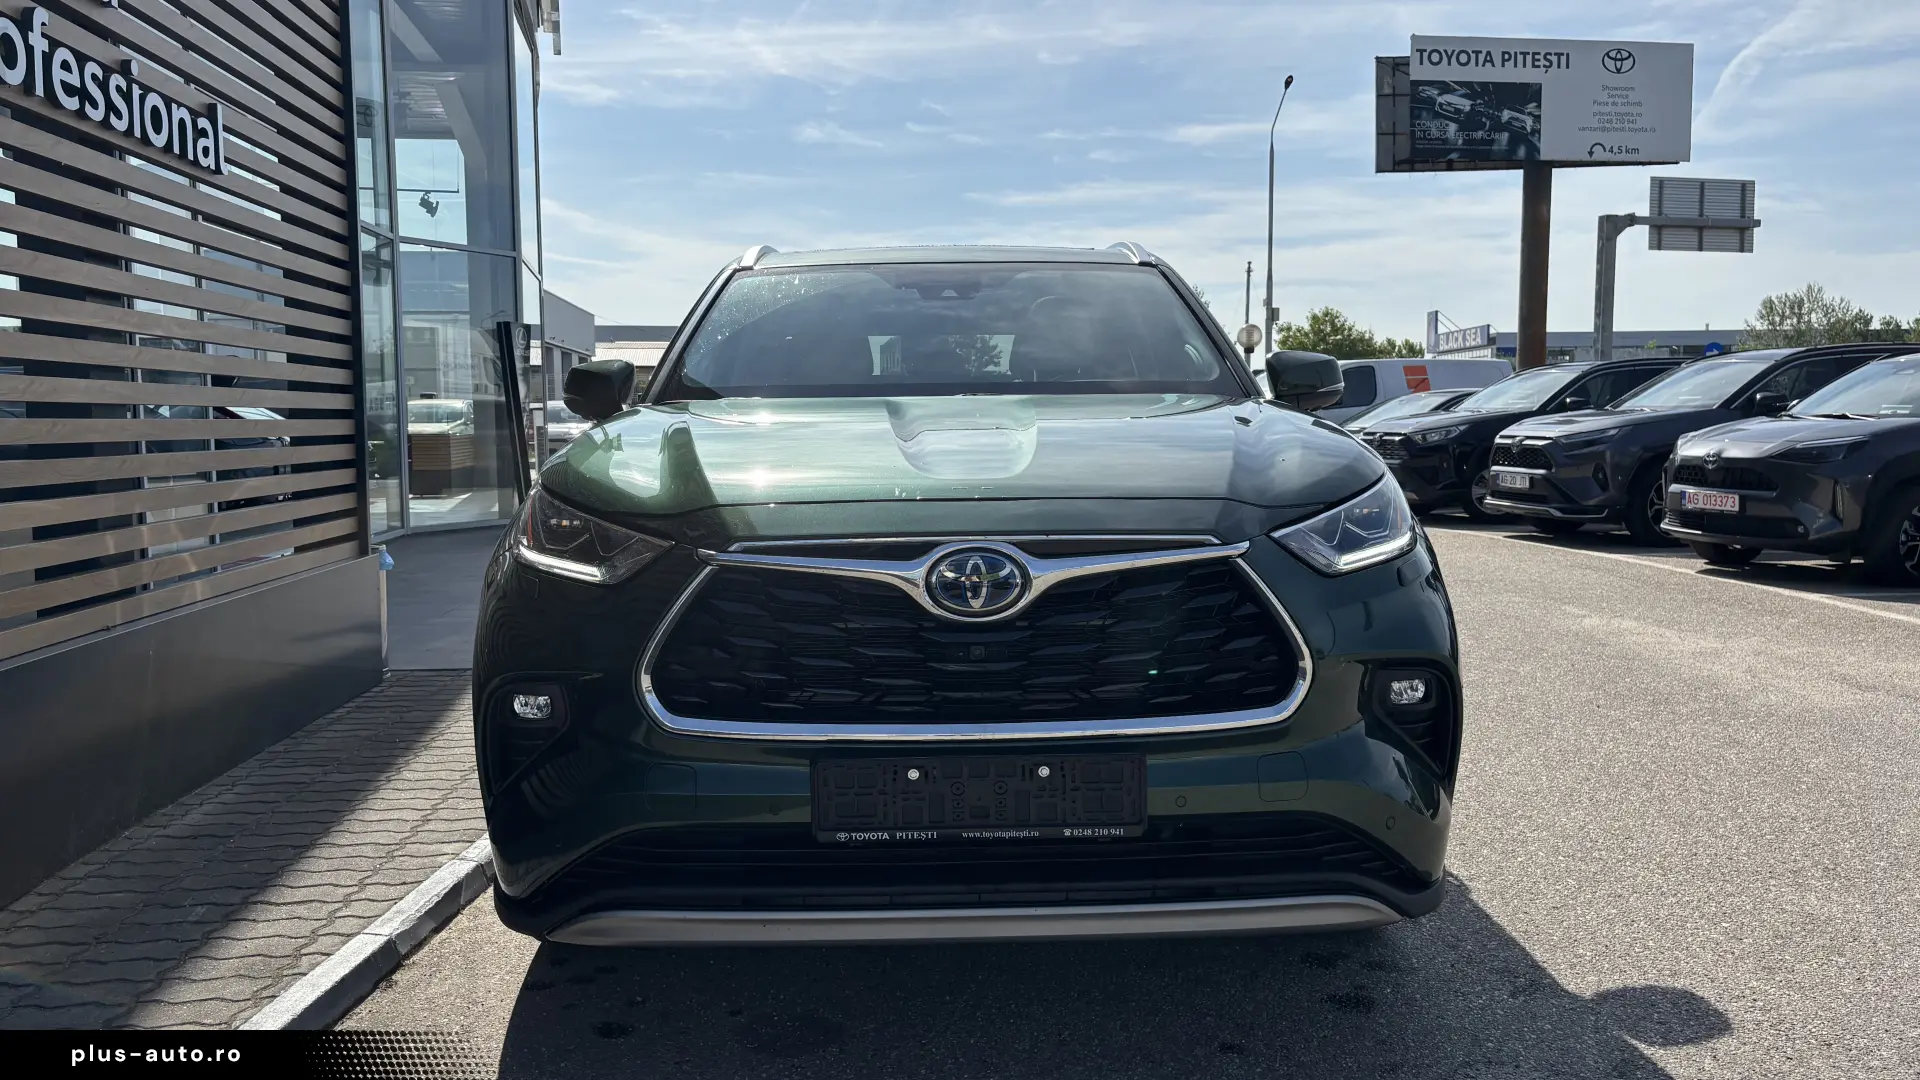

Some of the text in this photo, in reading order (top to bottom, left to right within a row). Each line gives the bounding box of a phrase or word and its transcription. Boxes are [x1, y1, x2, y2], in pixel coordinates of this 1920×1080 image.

[1415, 48, 1496, 68] TOYOTA
[1601, 84, 1636, 92] Showroom
[1606, 92, 1630, 100] Service
[1592, 99, 1643, 108] Piese de schimb
[1592, 111, 1643, 119] pitesti.toyota.ro
[1597, 117, 1614, 125] 0248
[1614, 117, 1626, 125] 210
[1608, 144, 1640, 156] 4,5 km
[1439, 327, 1481, 351] BLACK SEA
[1500, 474, 1508, 484] AG
[1686, 492, 1736, 509] AG 013373
[850, 832, 890, 841] TOYOTA
[1073, 828, 1093, 837] 0248
[1094, 828, 1109, 837] 210
[1110, 827, 1125, 836] 941
